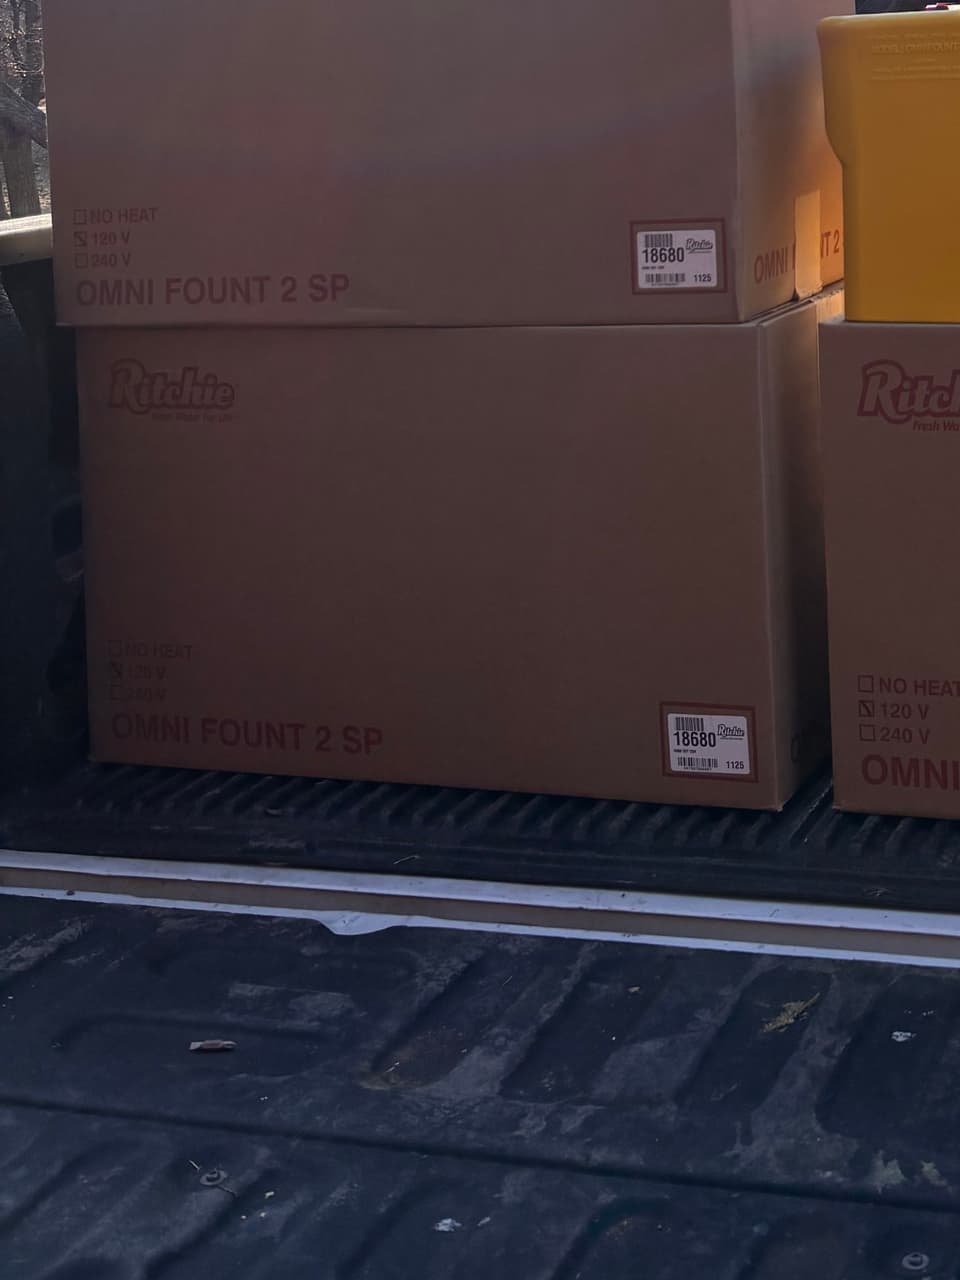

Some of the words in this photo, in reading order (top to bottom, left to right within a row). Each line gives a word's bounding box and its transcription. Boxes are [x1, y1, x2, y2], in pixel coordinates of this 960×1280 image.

[90, 208, 113, 223] NO
[117, 207, 159, 223] HEAT
[92, 231, 118, 246] 120
[121, 231, 131, 244] V
[121, 253, 131, 267] V
[642, 247, 685, 263] 18680
[754, 246, 788, 284] OMNI
[834, 230, 840, 254] 2
[693, 274, 712, 282] 1125
[76, 278, 154, 306] OMNI
[165, 276, 271, 305] FOUNT
[281, 275, 297, 304] 2
[308, 273, 350, 304] SP
[109, 358, 236, 415] Ritchie
[913, 421, 940, 432] Fresh
[879, 677, 907, 694] NO
[881, 703, 912, 719] 120
[917, 703, 930, 720] V
[112, 712, 191, 744] OMNI
[201, 717, 306, 750] FOUNT
[315, 725, 332, 753] 2
[342, 724, 383, 756] SP
[673, 732, 717, 748] 18680
[879, 727, 913, 744] 240
[918, 728, 931, 745] V
[725, 760, 745, 770] 1125
[861, 754, 960, 791] OMNI
